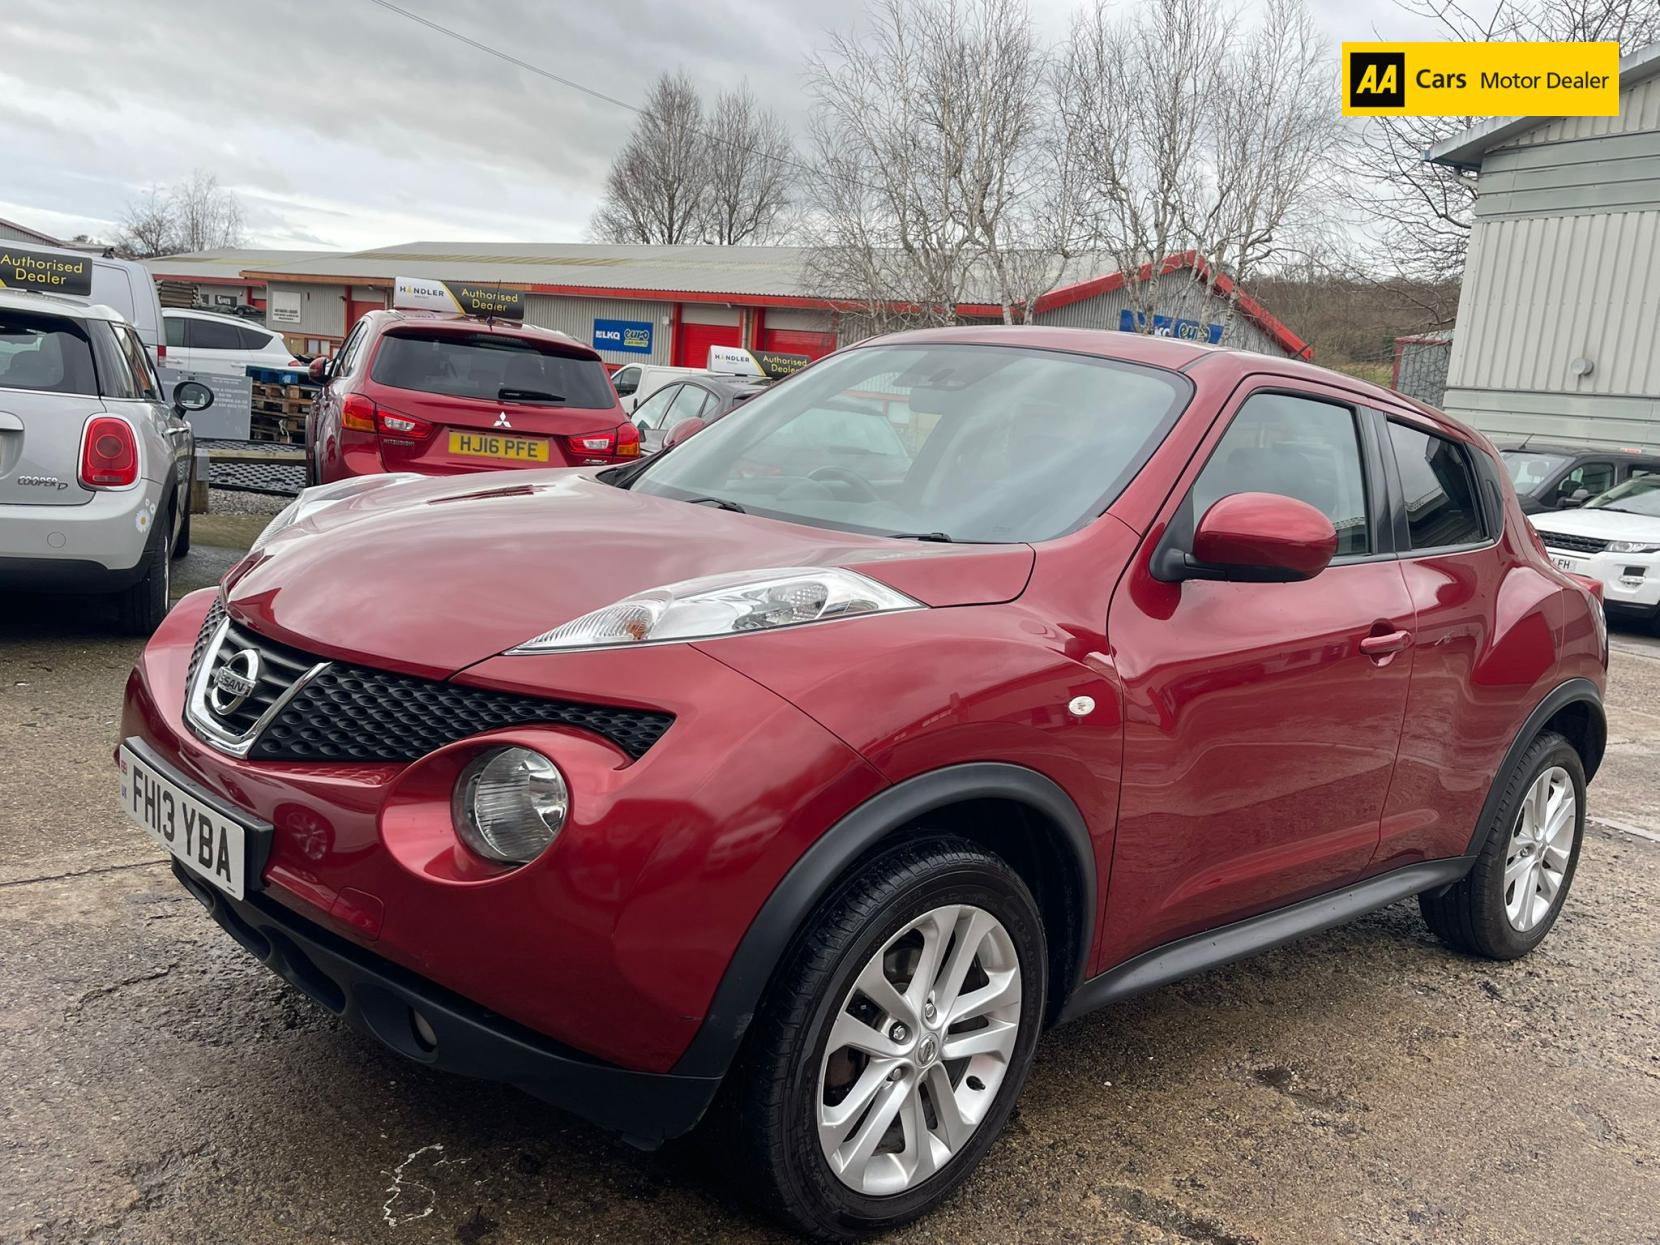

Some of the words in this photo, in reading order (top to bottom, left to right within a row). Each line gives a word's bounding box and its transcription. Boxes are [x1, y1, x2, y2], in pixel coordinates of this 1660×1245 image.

[0, 254, 83, 274] Authorised
[15, 267, 67, 285] Dealer
[461, 288, 518, 303] Authorised
[472, 299, 508, 312] Dealer
[763, 355, 808, 367] Authorised
[460, 436, 500, 454] HJ16
[505, 440, 538, 458] PFE
[18, 475, 57, 487] COOPER
[57, 482, 69, 491] D
[133, 764, 176, 843] FH13
[182, 802, 232, 884] YBA
